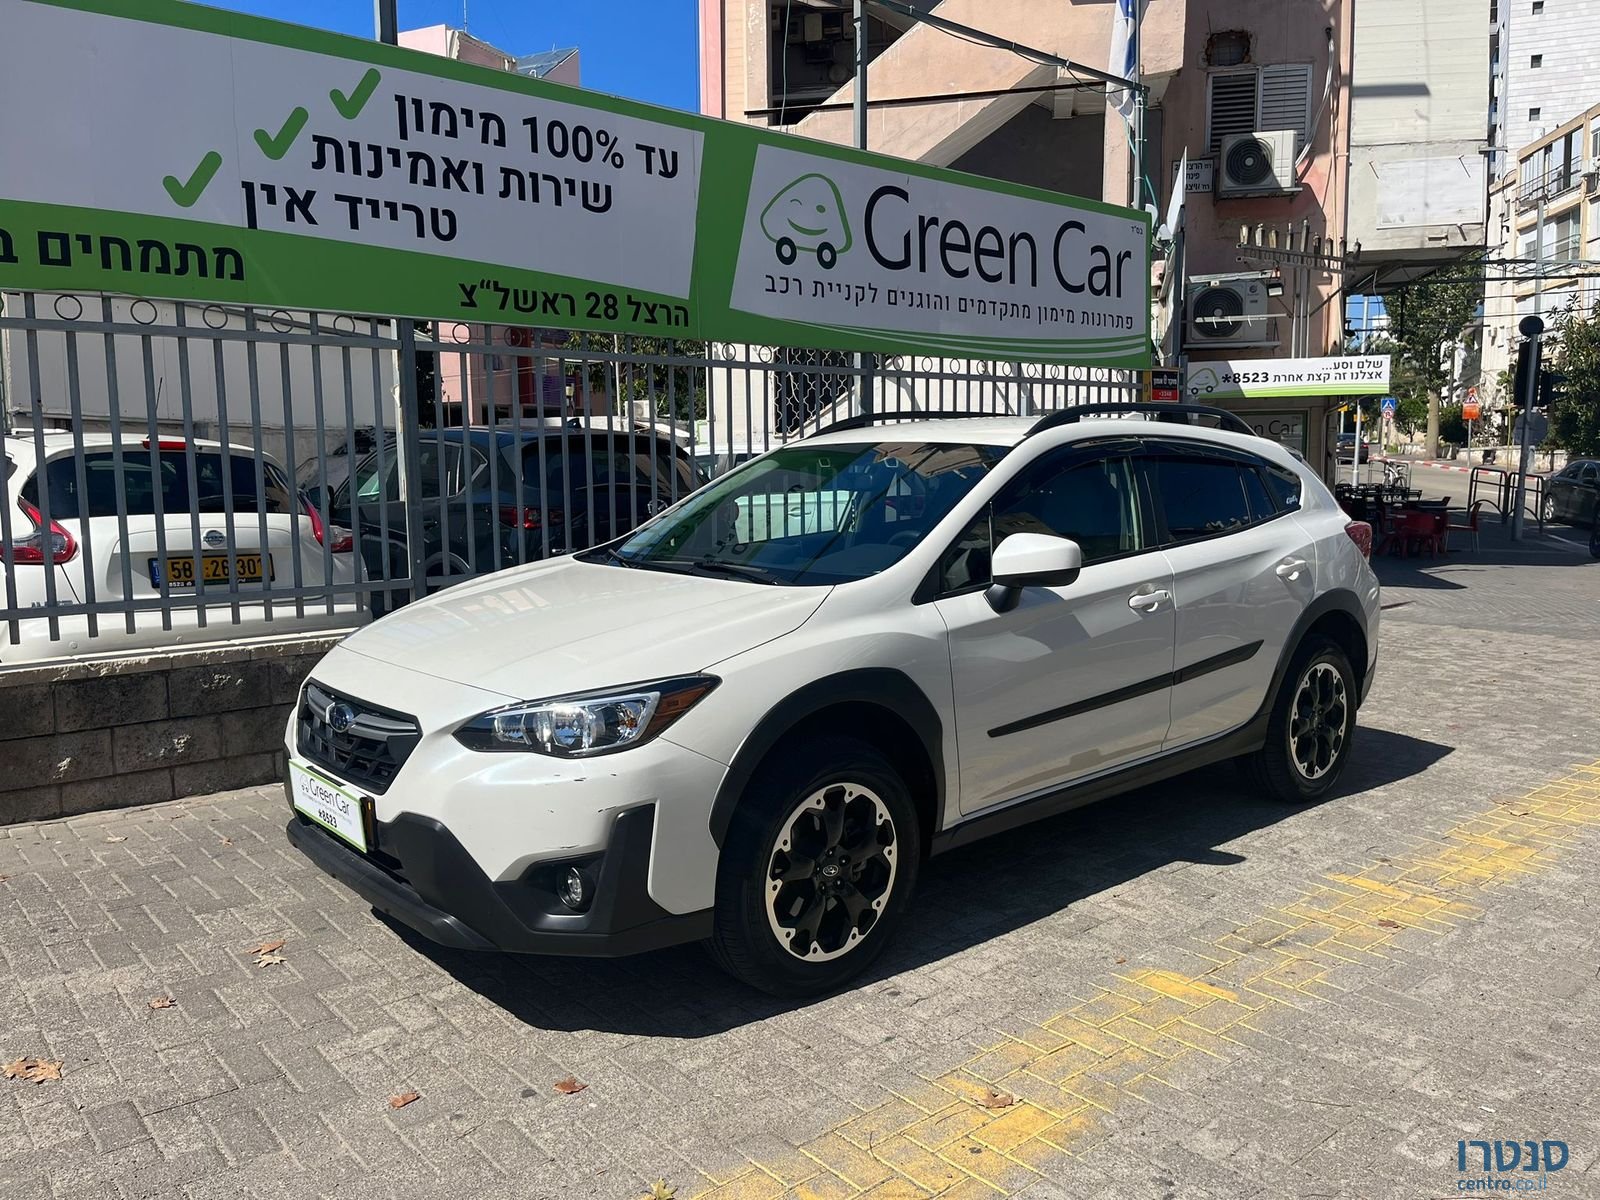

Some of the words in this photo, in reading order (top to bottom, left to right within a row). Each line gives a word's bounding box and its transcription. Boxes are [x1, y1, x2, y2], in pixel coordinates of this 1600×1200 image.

[394, 93, 507, 148] מימון
[523, 117, 625, 168] 100%
[311, 134, 485, 195] ואמינות
[636, 144, 679, 179] עד
[499, 166, 613, 214] שירות
[241, 180, 319, 231] אין
[334, 193, 457, 242] טרייד
[36, 230, 245, 282] מתמחים
[863, 185, 1038, 289] Green
[1051, 219, 1132, 299] Car
[764, 273, 803, 297] רכב
[812, 278, 879, 308] לקניית
[584, 291, 619, 321] 28
[625, 293, 690, 328] הרצל
[887, 288, 950, 313] והוגנים
[958, 296, 1032, 322] מתקדמים
[1037, 305, 1076, 325] מימון
[1081, 310, 1134, 329] פתרונות
[1272, 373, 1304, 383] אחרת
[1306, 371, 1331, 384] קצת
[1334, 371, 1347, 381] זה
[1350, 370, 1384, 381] אצלנו
[1356, 358, 1384, 370] שלם
[1268, 419, 1299, 436] Car
[310, 778, 335, 806] Green
[335, 793, 350, 816] Car
